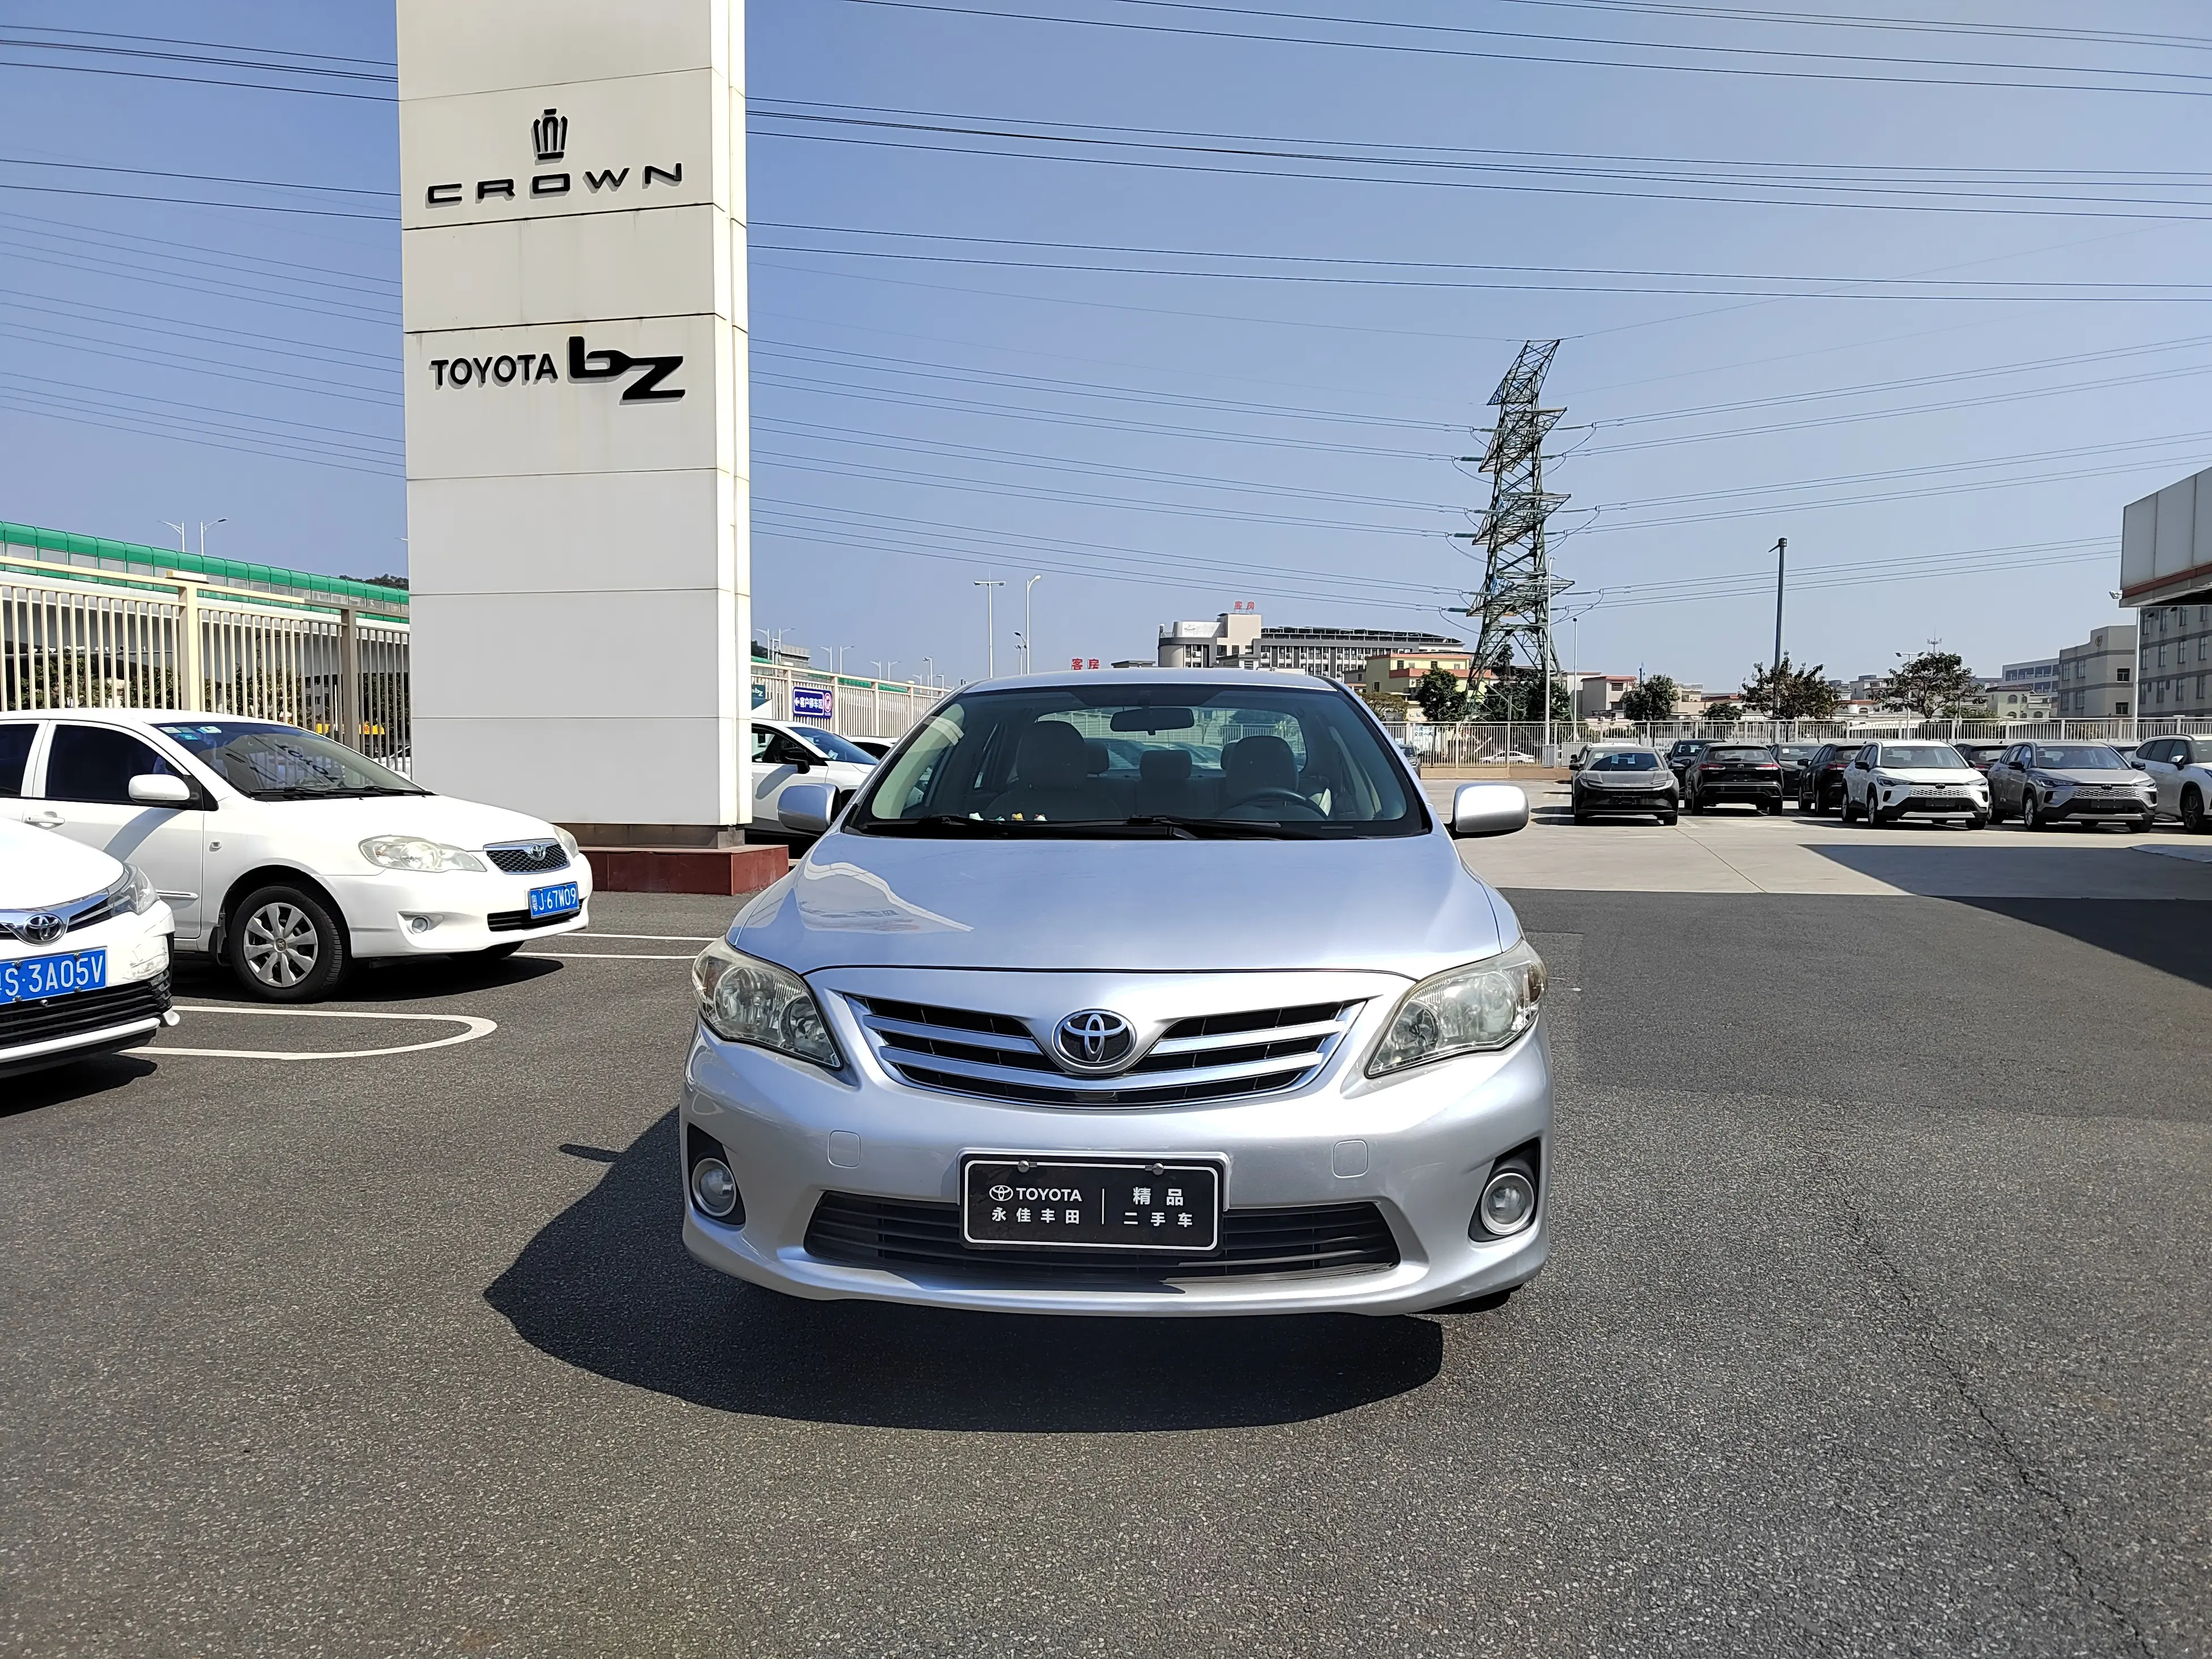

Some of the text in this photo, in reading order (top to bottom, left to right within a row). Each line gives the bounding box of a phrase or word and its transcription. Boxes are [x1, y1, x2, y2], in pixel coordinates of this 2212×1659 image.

[427, 163, 682, 204] CROWN
[431, 353, 558, 386] TOYOTA
[1071, 658, 1100, 670] 客房
[1015, 1187, 1083, 1202] TOYOTA
[1132, 1186, 1184, 1206] 精品
[991, 1206, 1080, 1225] 永佳丰田
[1123, 1211, 1193, 1228] 二手车
